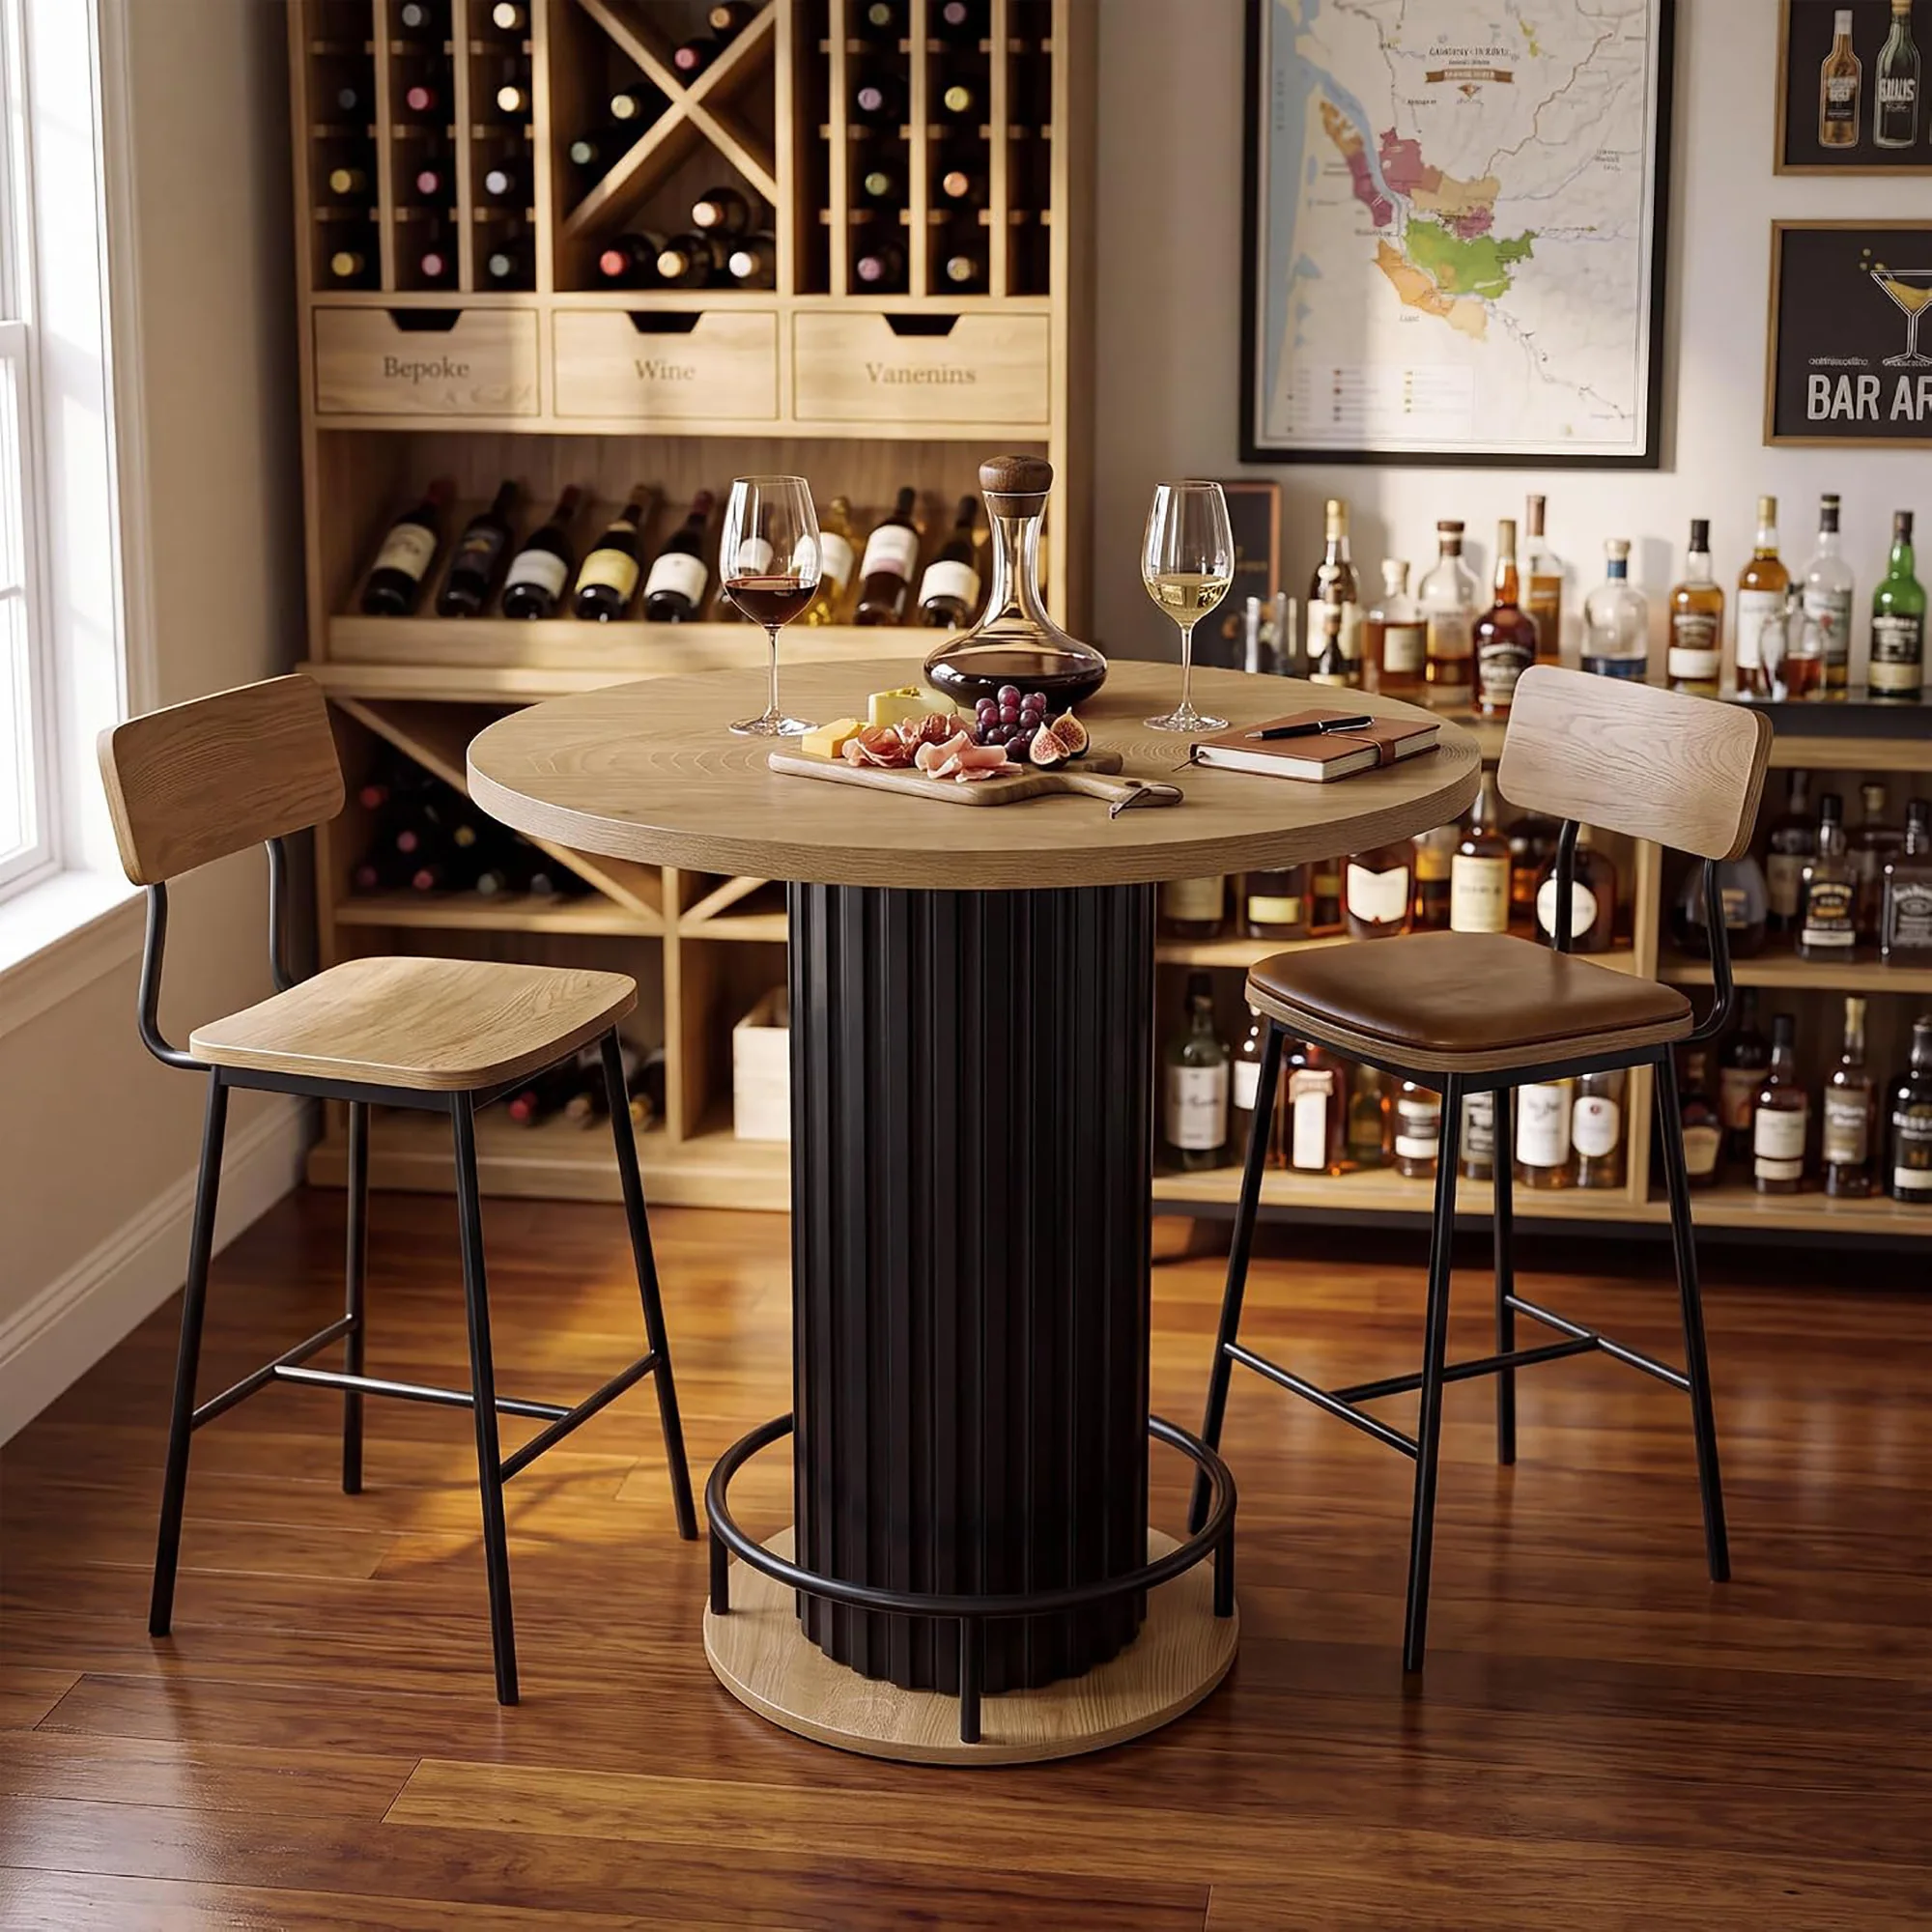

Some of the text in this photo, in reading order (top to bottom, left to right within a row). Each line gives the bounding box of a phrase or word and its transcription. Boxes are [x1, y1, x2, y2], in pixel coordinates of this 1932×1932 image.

[384, 355, 470, 385] Bepoke
[635, 358, 696, 381] Wine
[1807, 374, 1880, 420] BAR
